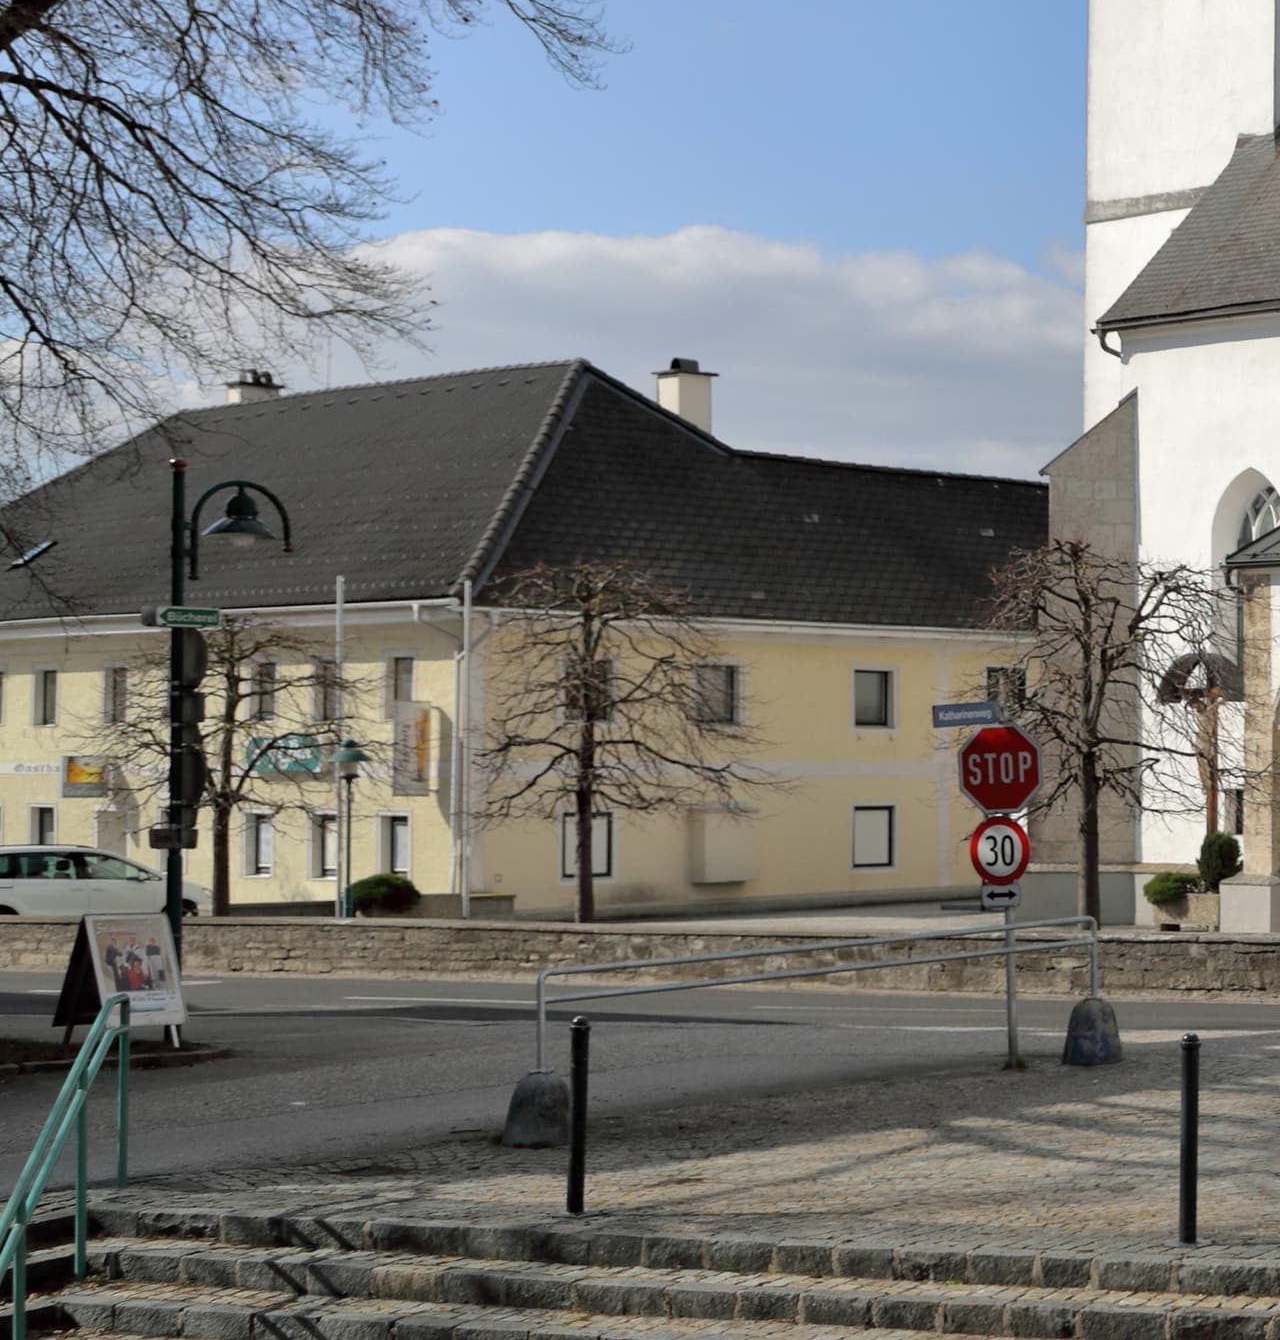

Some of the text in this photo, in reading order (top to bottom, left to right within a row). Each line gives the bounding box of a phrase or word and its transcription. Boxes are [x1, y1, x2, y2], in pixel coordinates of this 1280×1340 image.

[167, 611, 218, 623] Bücherei
[968, 751, 1032, 786] STOP
[985, 834, 1014, 867] 30
